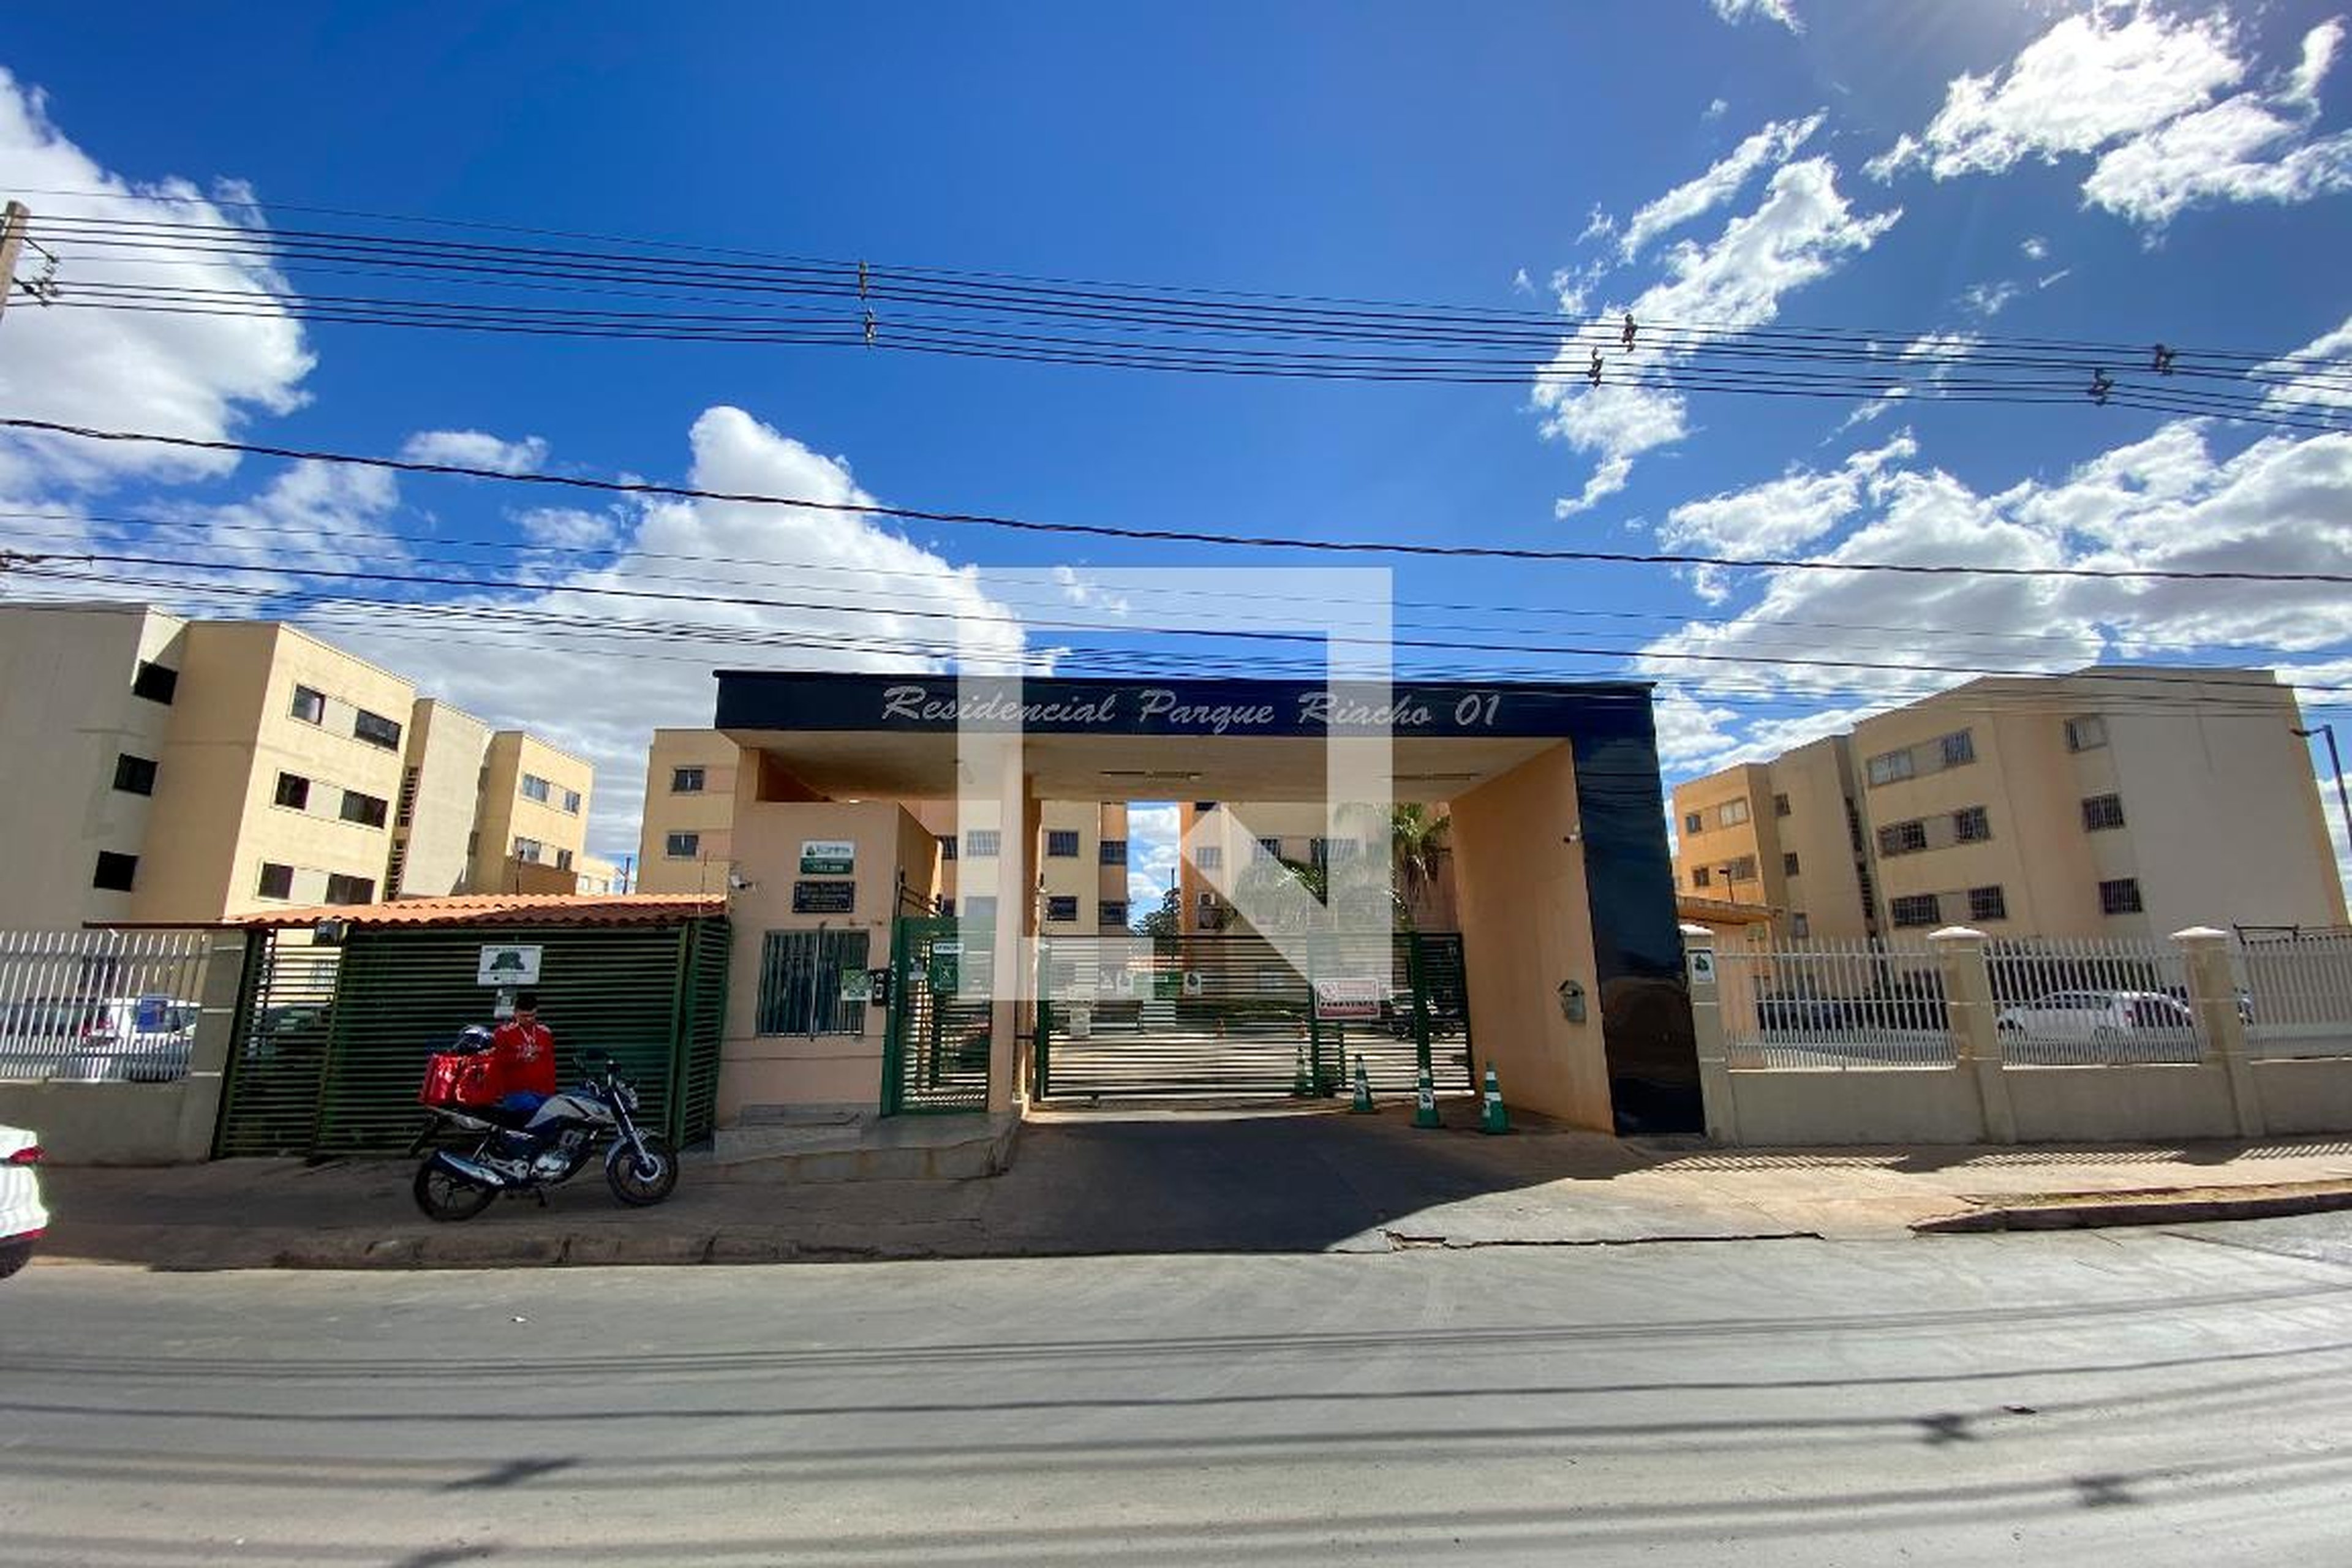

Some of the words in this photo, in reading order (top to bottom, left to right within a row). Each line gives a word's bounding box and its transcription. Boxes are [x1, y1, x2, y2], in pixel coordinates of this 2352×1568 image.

[881, 685, 1117, 723] Residencial
[1139, 689, 1275, 735] Parque
[1298, 692, 1432, 725] Riacho
[1455, 694, 1500, 726] 01
